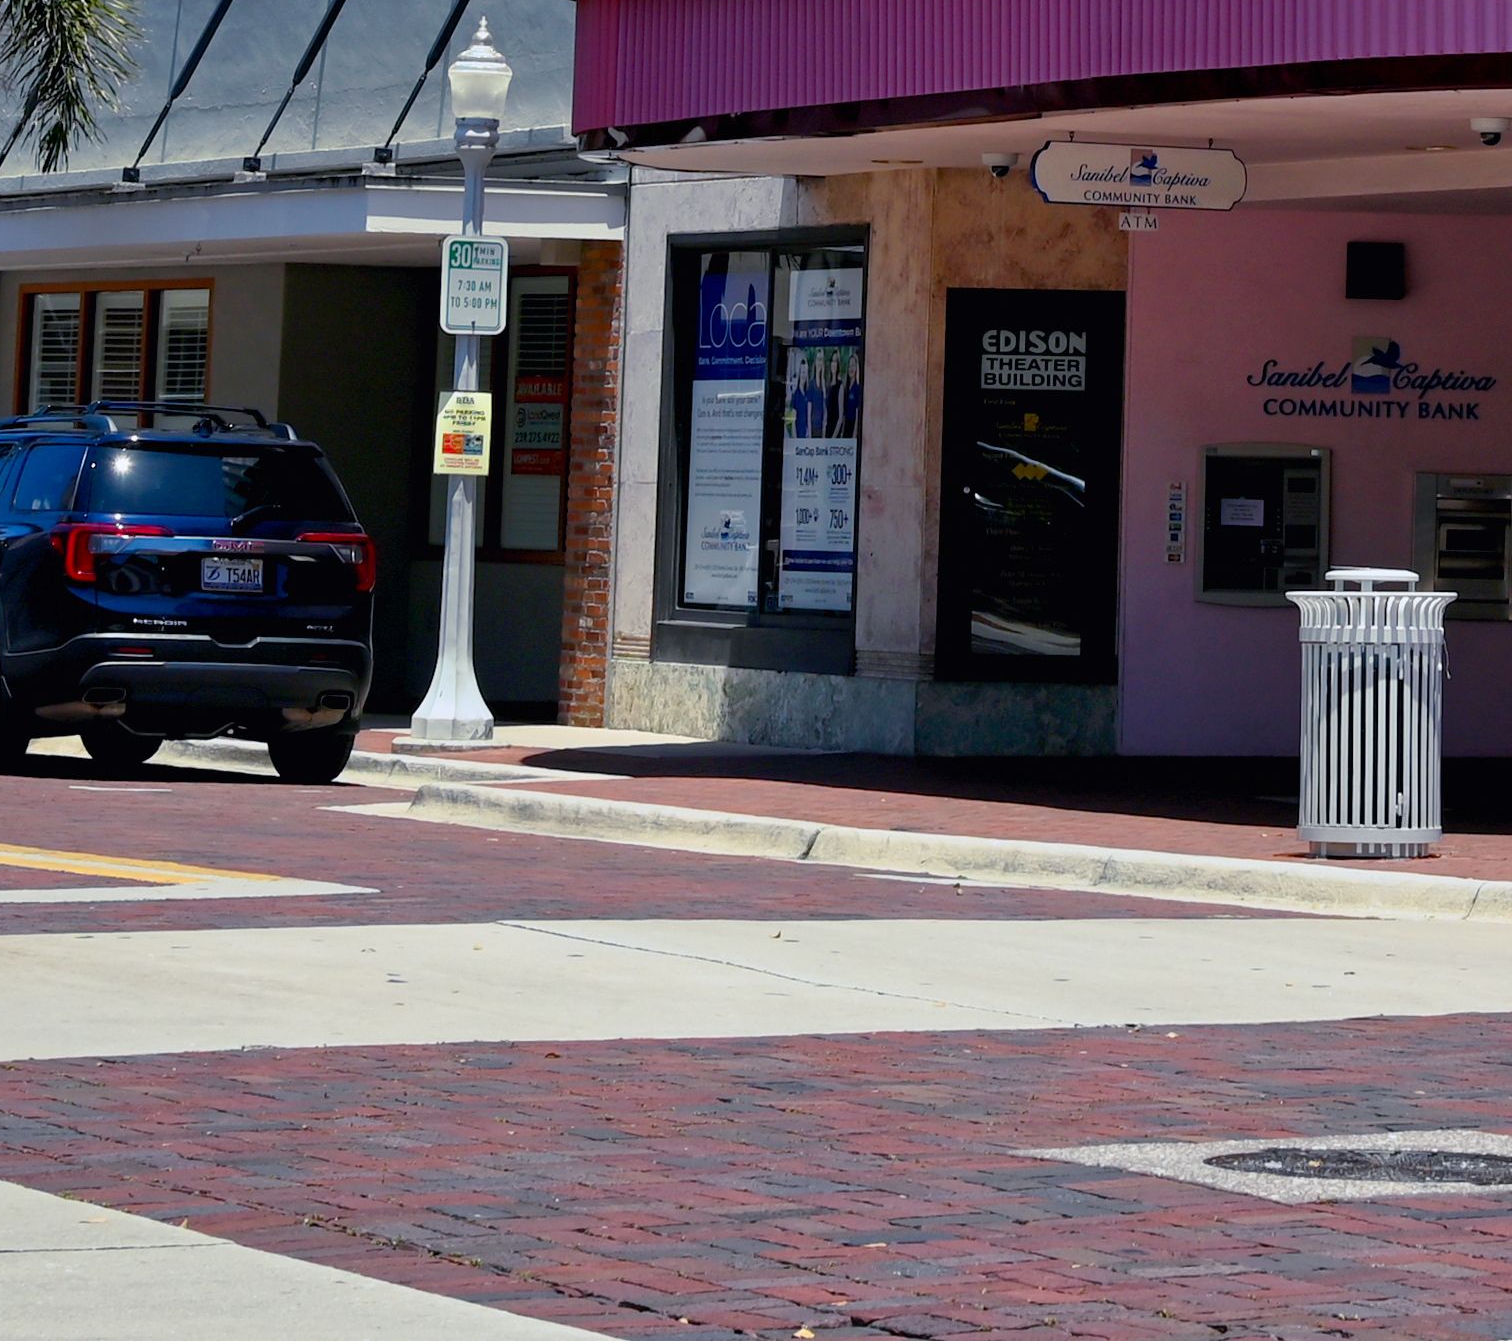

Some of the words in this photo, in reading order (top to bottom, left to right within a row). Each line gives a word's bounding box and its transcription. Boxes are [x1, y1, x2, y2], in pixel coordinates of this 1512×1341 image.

[1070, 163, 1129, 182] Sanibel
[1151, 167, 1210, 191] Captiva
[1083, 190, 1160, 204] COMMUNITY
[1164, 192, 1197, 205] BANK
[1120, 215, 1158, 229] ATM
[451, 243, 472, 267] 30
[457, 279, 476, 292] 7:30
[479, 280, 492, 292] AM
[451, 296, 461, 308] TO
[464, 297, 482, 309] 5:00
[485, 298, 498, 310] PM
[982, 330, 1087, 355] EDISON
[985, 357, 1081, 372] THEATER
[983, 373, 1083, 388] BUILDING
[1246, 359, 1352, 388] Sanibel
[1393, 363, 1497, 399] Captiva
[516, 381, 563, 397] AVAILABLE
[1263, 398, 1409, 418] COMMUNITY
[1419, 402, 1480, 419] BANK
[829, 508, 849, 529] 750+
